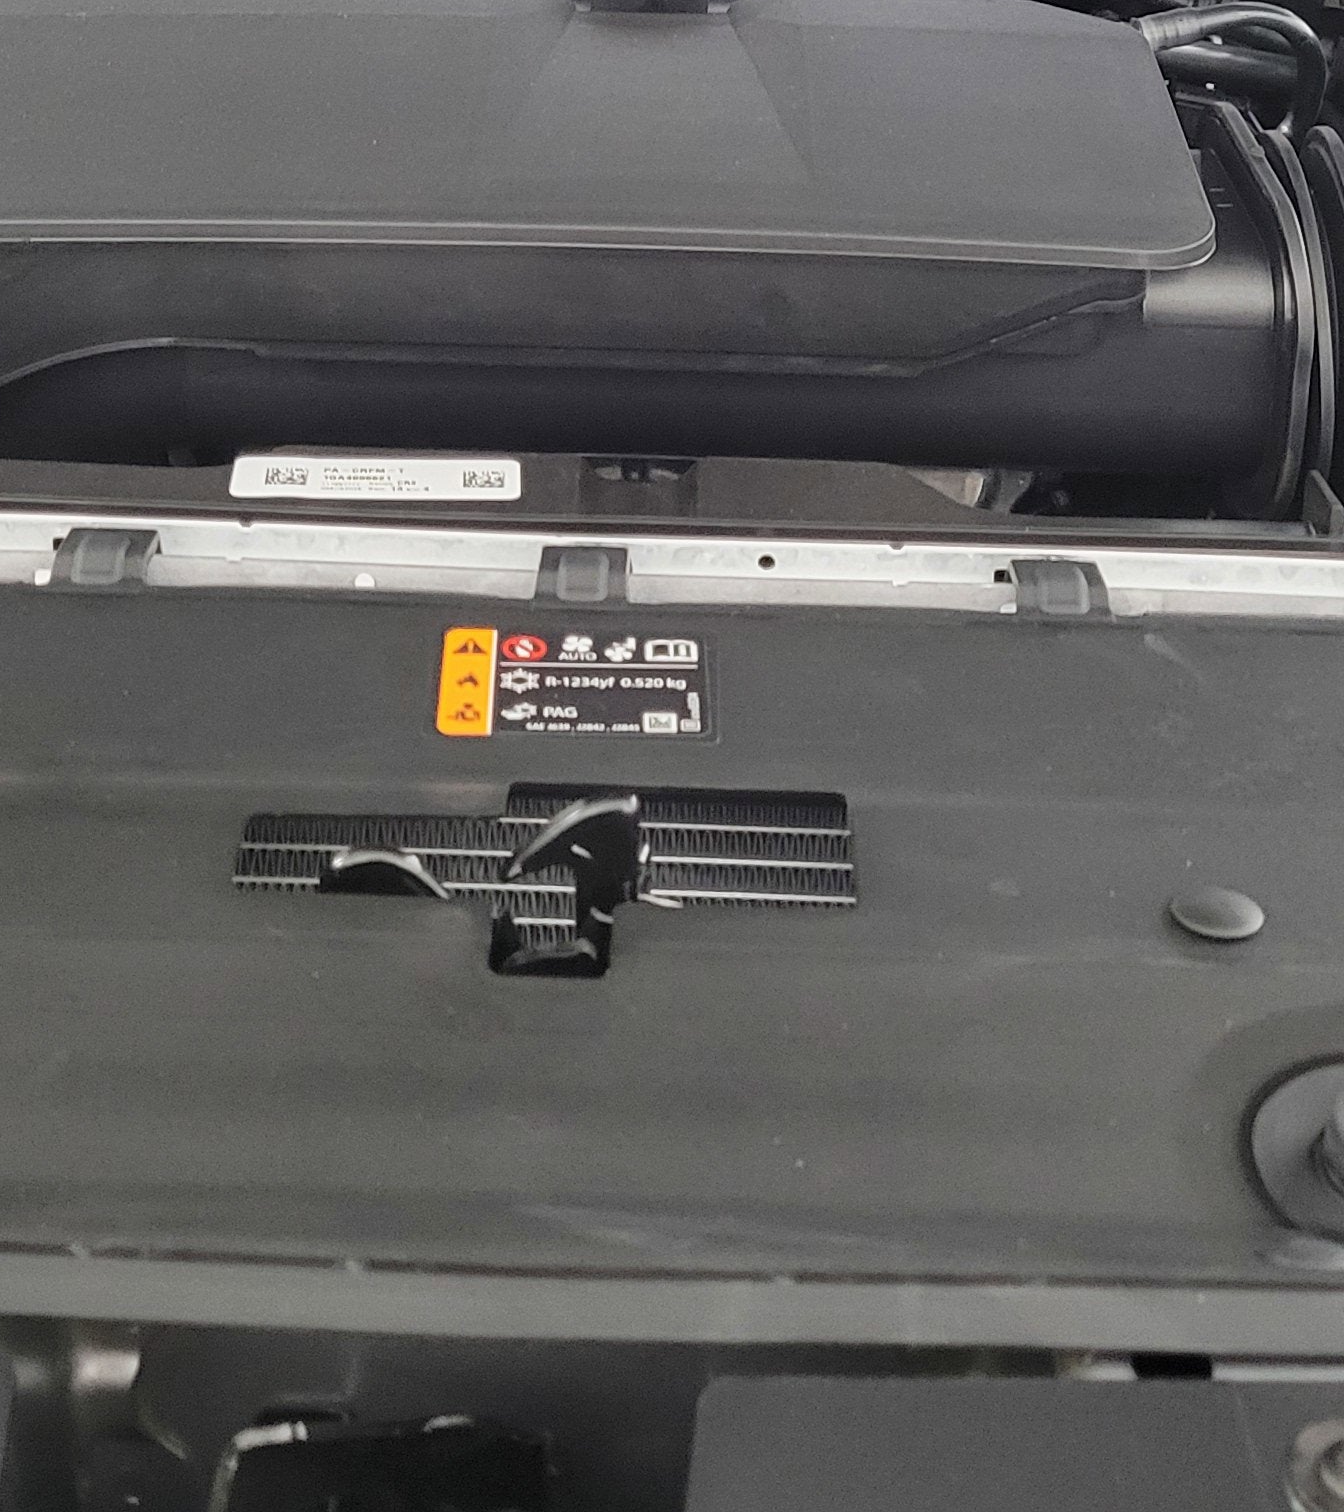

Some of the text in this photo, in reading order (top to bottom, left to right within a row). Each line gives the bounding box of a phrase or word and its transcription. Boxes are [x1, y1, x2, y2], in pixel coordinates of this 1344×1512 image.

[558, 651, 598, 661] AUTO
[544, 676, 687, 691] R-1234yf 0.520 kg
[542, 706, 578, 719] PAG
[525, 722, 546, 732] SAE
